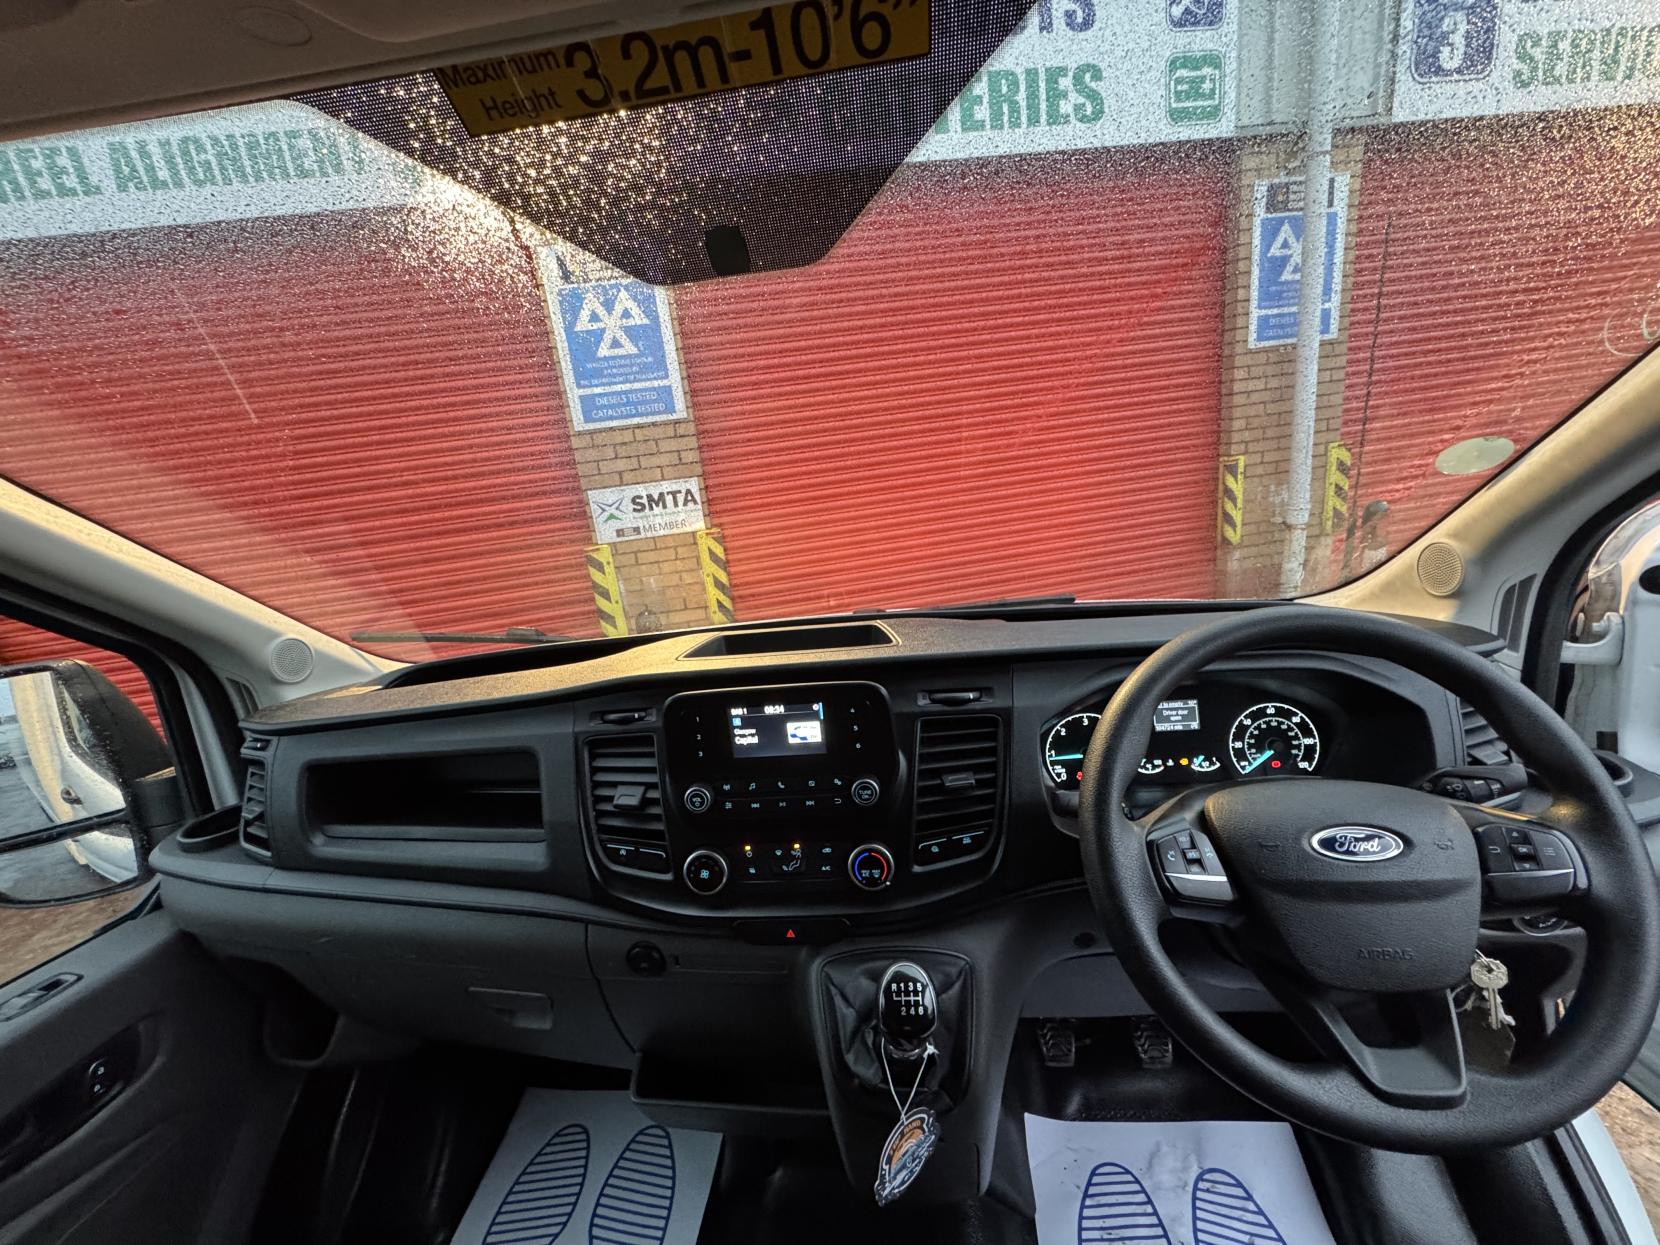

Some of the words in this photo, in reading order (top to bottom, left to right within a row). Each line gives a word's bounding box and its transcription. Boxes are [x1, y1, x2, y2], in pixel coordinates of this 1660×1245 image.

[439, 48, 561, 90] Maximum
[480, 84, 561, 121] Height
[934, 63, 1104, 134] ERIES
[595, 395, 626, 406] DIESELS
[628, 391, 657, 401] TESTED
[592, 406, 636, 418] CATALYSTS
[637, 403, 666, 413] TESTED
[630, 488, 700, 514] SMTA
[642, 519, 688, 535] MEMBER
[1335, 831, 1381, 854] Ford
[1358, 947, 1414, 961] AIRBAG
[892, 983, 898, 992] R
[908, 983, 914, 992] 3
[916, 983, 922, 992] 5
